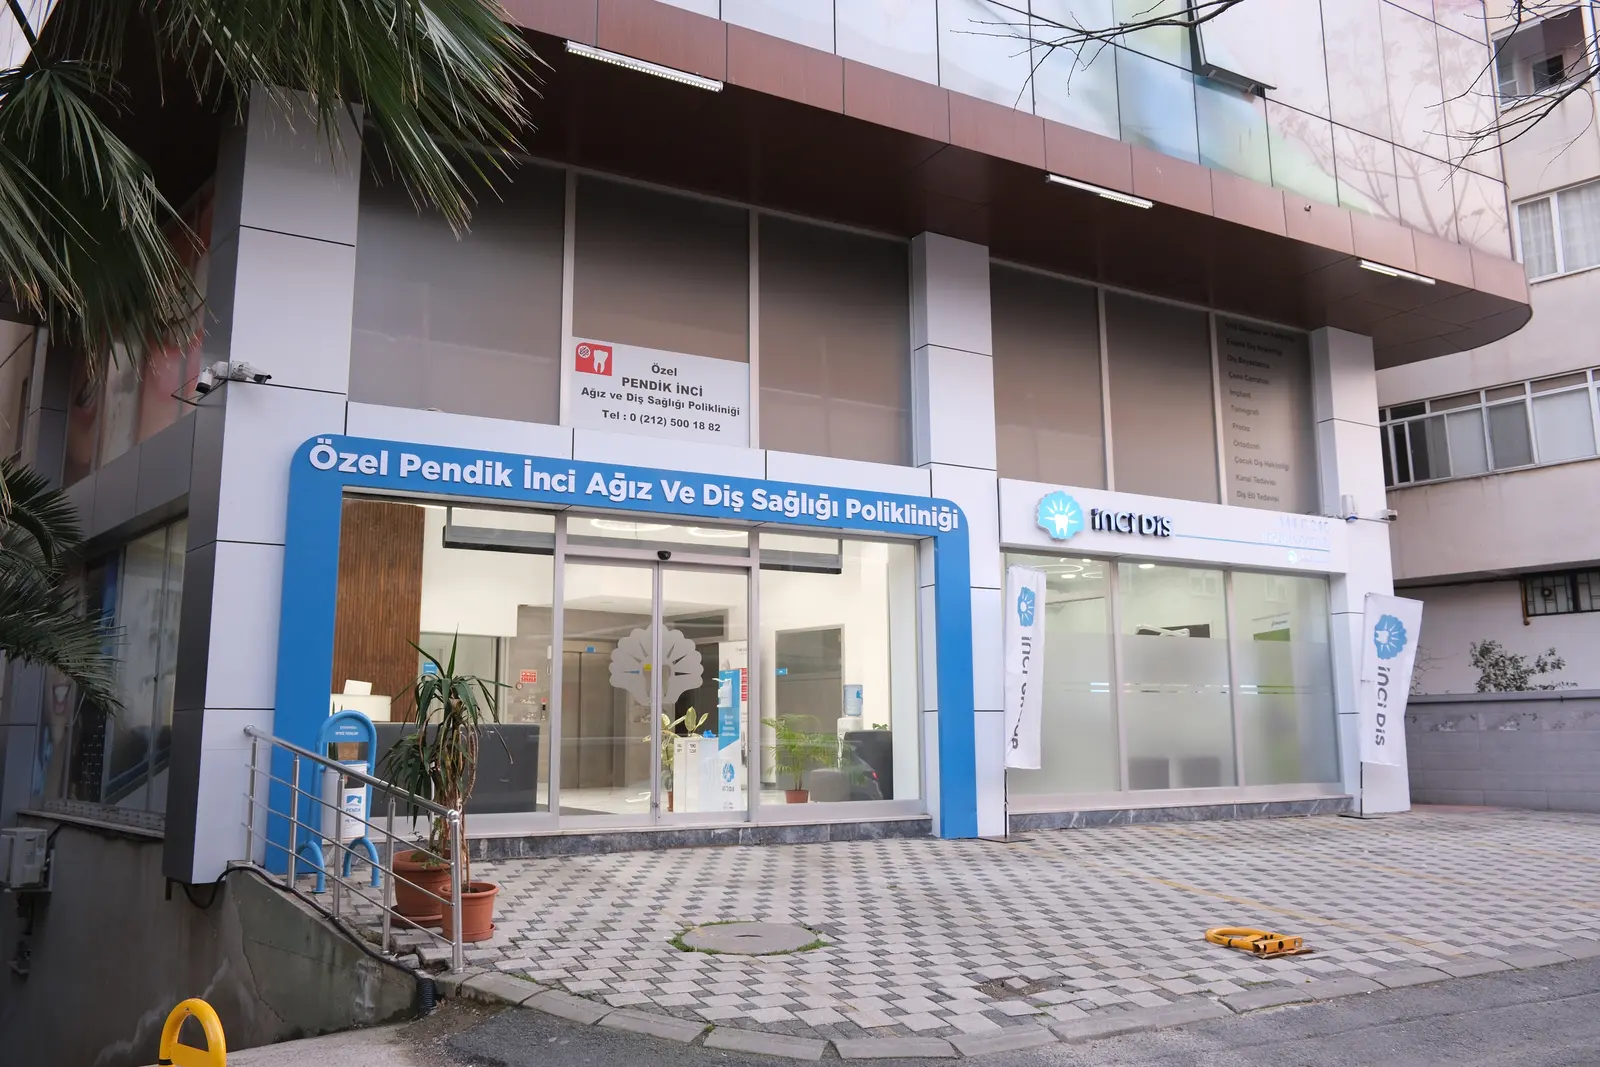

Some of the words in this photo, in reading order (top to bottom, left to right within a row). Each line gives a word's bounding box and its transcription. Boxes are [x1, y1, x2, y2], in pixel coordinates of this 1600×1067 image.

[651, 363, 677, 377] Özel
[622, 376, 673, 393] PENDİK
[676, 381, 703, 397] İNCİ
[581, 386, 606, 400] Ağız
[609, 392, 623, 401] ve
[626, 393, 644, 405] Diş
[647, 395, 685, 410] Sağlığı
[688, 401, 740, 417] Polikliniği
[602, 409, 620, 420] Tel
[629, 412, 637, 422] 0
[640, 413, 667, 427] (212)
[670, 417, 690, 429] 500
[693, 420, 705, 430] 18
[708, 422, 721, 432] 82
[309, 437, 388, 476] Özel
[400, 452, 513, 488] Pendik
[524, 459, 576, 493] İnci
[585, 471, 652, 502] Ağız
[660, 479, 696, 505] Ve
[703, 483, 745, 513] Diş
[752, 488, 839, 520] Sağlığı
[846, 498, 959, 532] Polikliniği
